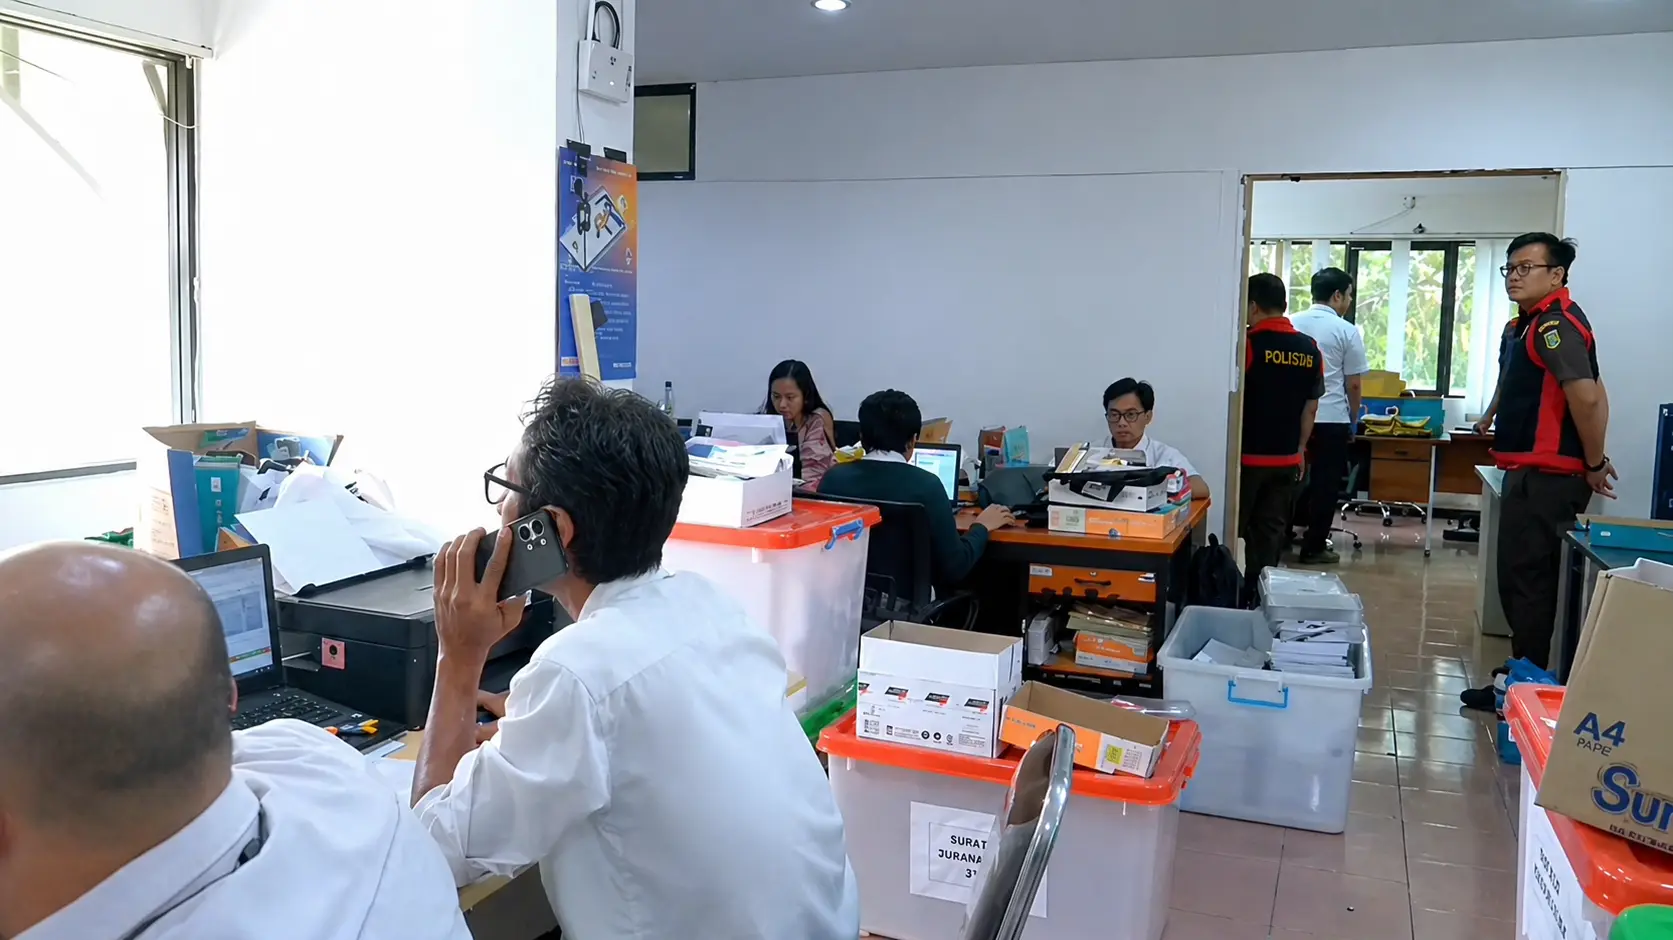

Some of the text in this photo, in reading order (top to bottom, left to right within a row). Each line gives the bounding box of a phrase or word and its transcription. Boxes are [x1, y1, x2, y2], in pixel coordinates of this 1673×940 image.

[1573, 711, 1626, 748] A4
[1576, 737, 1612, 757] PAPE
[950, 835, 987, 850] SURAT
[938, 848, 982, 864] JURANA
